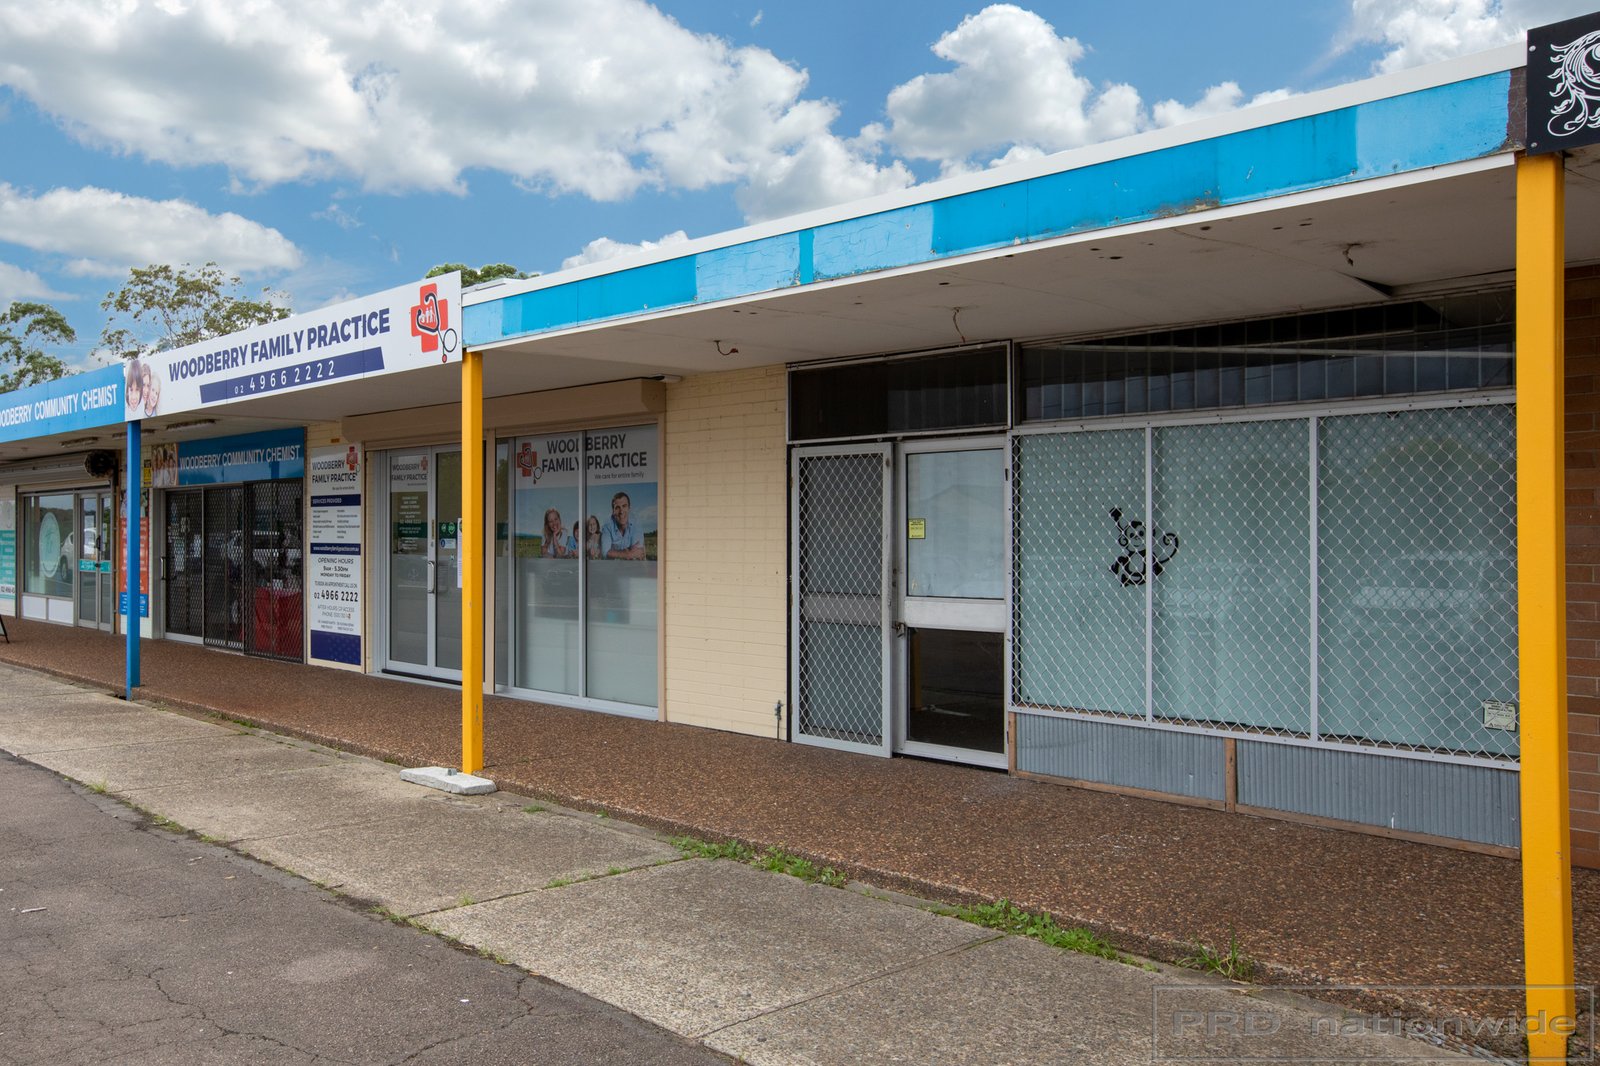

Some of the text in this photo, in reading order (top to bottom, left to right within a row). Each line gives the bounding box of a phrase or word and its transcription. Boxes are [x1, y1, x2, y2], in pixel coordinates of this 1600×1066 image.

[169, 307, 391, 382] WOODBERRY FAMILY PRACTICE
[234, 360, 335, 395] 02 4966 2222
[34, 393, 79, 420] COMMUNITY
[81, 384, 118, 411] CHEMIST
[180, 445, 300, 471] WOODBERRY COMMUNITY CHEMIST
[312, 460, 345, 471] WOODBERRY
[587, 451, 647, 470] PRACTICE
[392, 463, 420, 471] WOODBERRY
[312, 472, 356, 484] FAMILY PRACTICE
[406, 473, 427, 481] PRACTICE
[313, 589, 359, 603] 02 4966 2222
